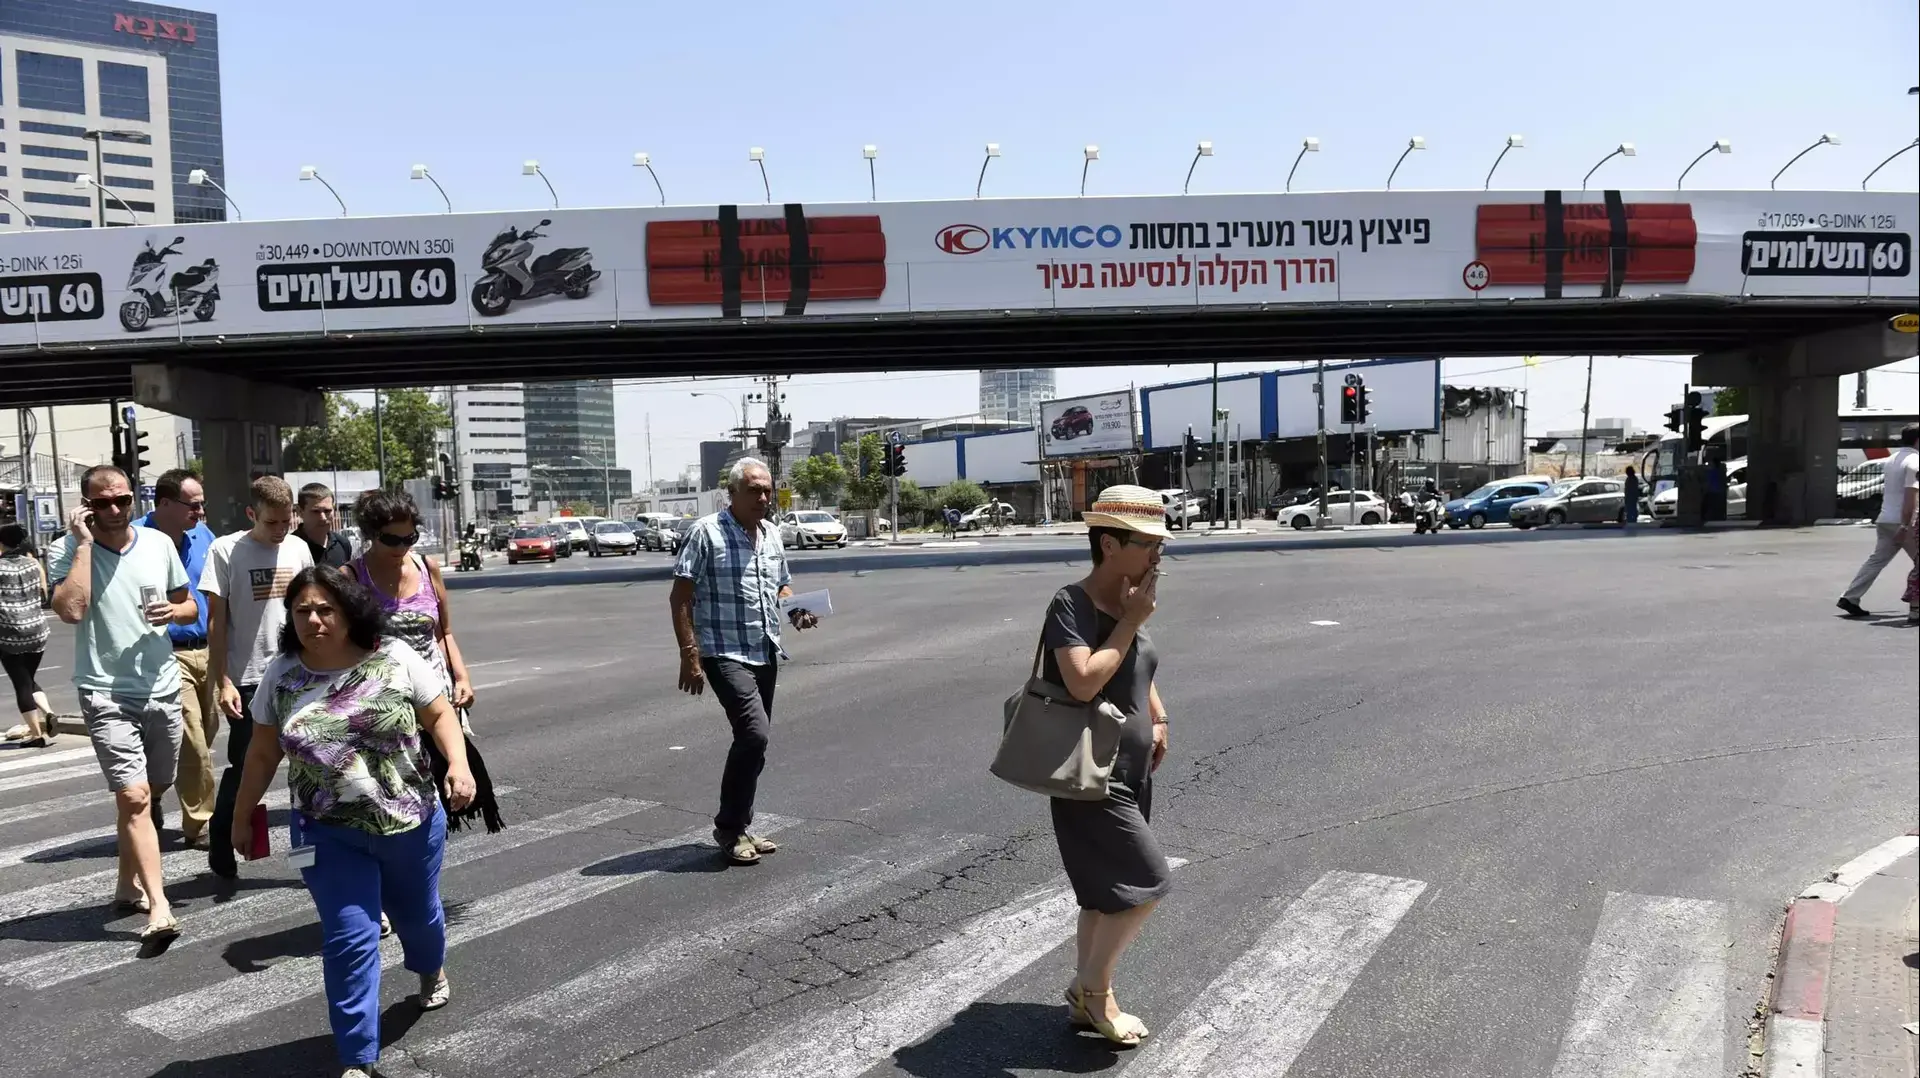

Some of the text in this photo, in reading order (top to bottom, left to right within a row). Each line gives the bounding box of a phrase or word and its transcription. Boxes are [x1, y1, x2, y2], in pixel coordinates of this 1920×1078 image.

[1818, 213, 1867, 228] G-DINK
[1870, 215, 1897, 229] 125i
[323, 240, 420, 258] DOWNTOWN
[424, 238, 455, 255] 350i
[992, 224, 1123, 249] KYMCO
[1129, 218, 1431, 253] פיצוץ גשר מעריב בחסות
[53, 254, 84, 270] 125i
[1872, 242, 1904, 270] 60
[410, 268, 448, 299] 60
[1036, 253, 1335, 292] הדרך הקלה לנסיעה בעיר
[59, 282, 95, 313] 60
